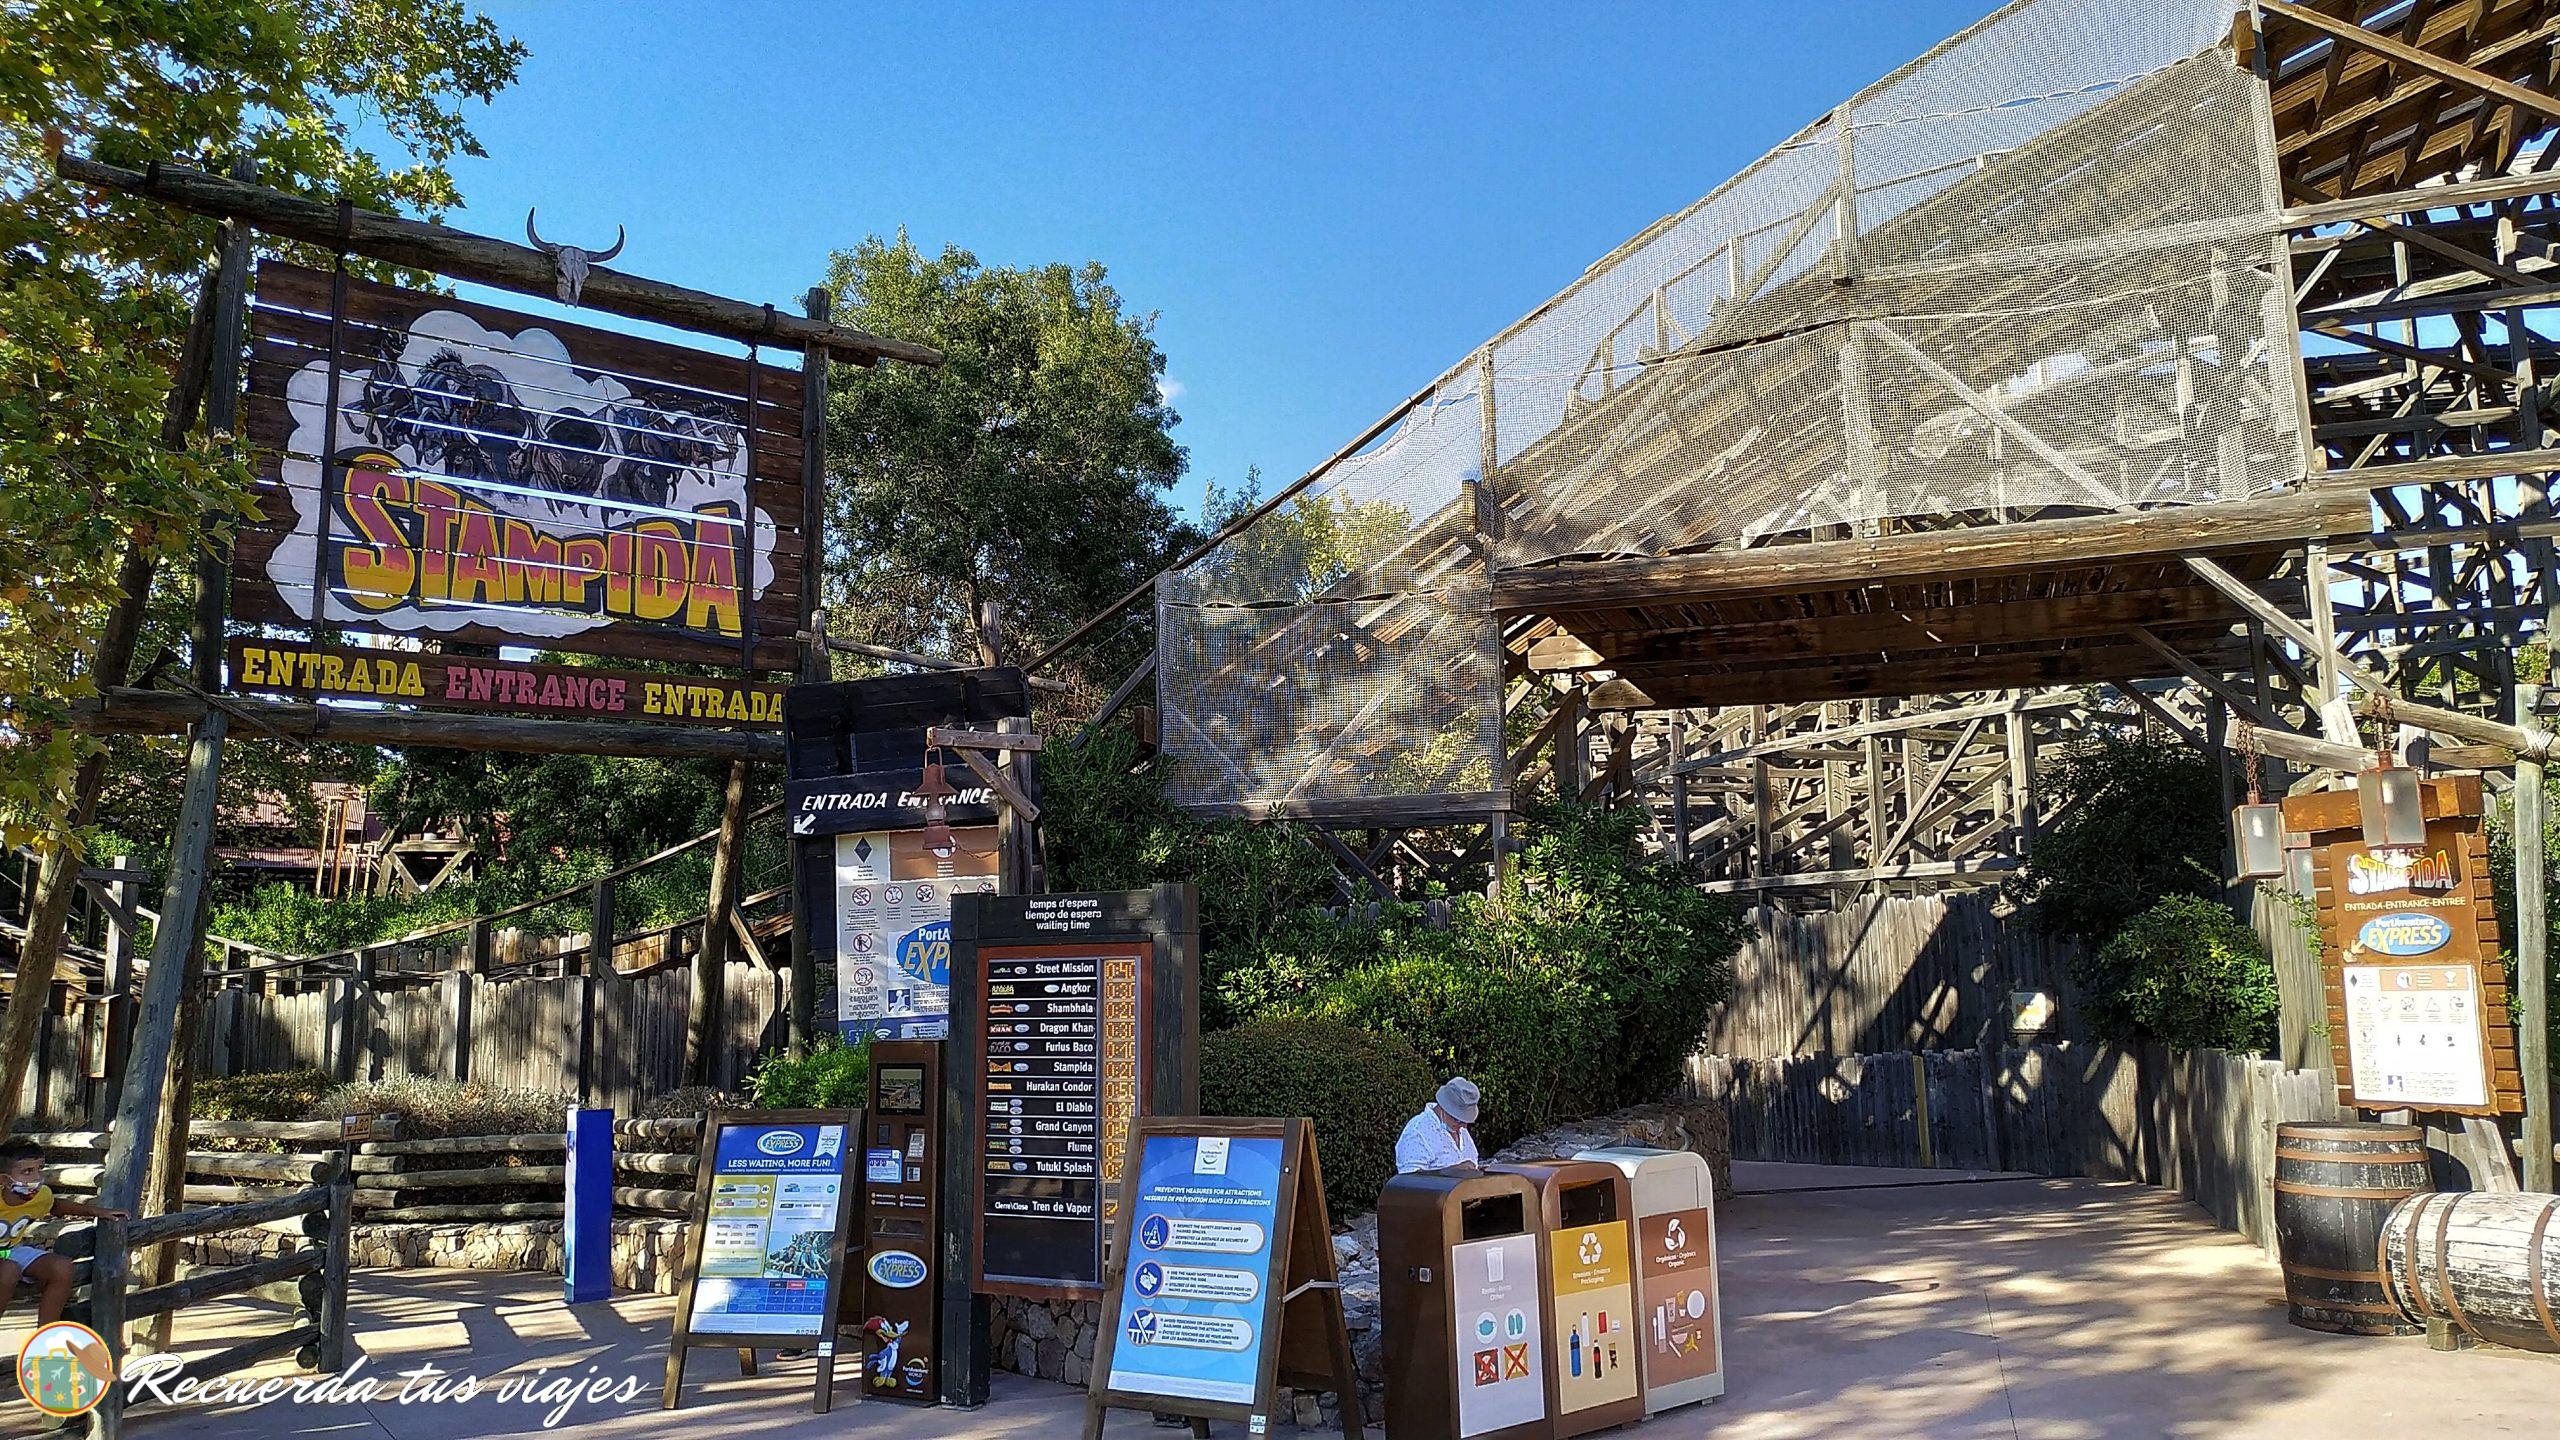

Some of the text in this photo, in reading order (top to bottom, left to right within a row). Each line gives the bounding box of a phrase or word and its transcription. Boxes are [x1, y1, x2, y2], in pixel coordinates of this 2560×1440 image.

[342, 451, 743, 636] STAMPIDA
[241, 647, 783, 723] ENTRADA ENTRANCE ENTRADA
[802, 788, 992, 811] ENTRADA ENANCE
[2348, 850, 2454, 895] STAMPIDA
[1030, 899, 1097, 910] temps d'espera
[1025, 910, 1102, 920] tiempo de espera
[1036, 920, 1090, 931] waiting time
[2368, 925, 2442, 954] EXPRESS
[1035, 963, 1060, 974] Street
[1062, 963, 1094, 973] Mission
[1061, 983, 1091, 994] Angkor
[1047, 1003, 1093, 1014] Shambhala
[1040, 1023, 1069, 1034] Dragon
[1072, 1023, 1094, 1032] Khan
[1046, 1042, 1070, 1052] Furius
[1073, 1042, 1093, 1052] Baco
[1054, 1062, 1093, 1073] Stampida
[1026, 1082, 1060, 1092] Hurakan
[1063, 1082, 1092, 1092] Condor
[1056, 1103, 1064, 1112] El
[1066, 1103, 1093, 1112] Diablo
[1036, 1121, 1060, 1131] Grand
[1062, 1122, 1093, 1134] Canyon
[765, 1139, 800, 1151] EXPRESS
[1068, 1143, 1093, 1152] Flume
[728, 1160, 748, 1168] LESS
[749, 1160, 786, 1168] WAITING,
[787, 1159, 810, 1167] MORE
[1036, 1162, 1061, 1172] Tutuki
[1064, 1162, 1092, 1174] Splash
[1154, 1186, 1185, 1194] PREVENTIVE
[1032, 1202, 1051, 1211] Tren
[1053, 1202, 1064, 1211] de
[1066, 1203, 1091, 1215] Vapor
[878, 1264, 921, 1280] EXPRESS
